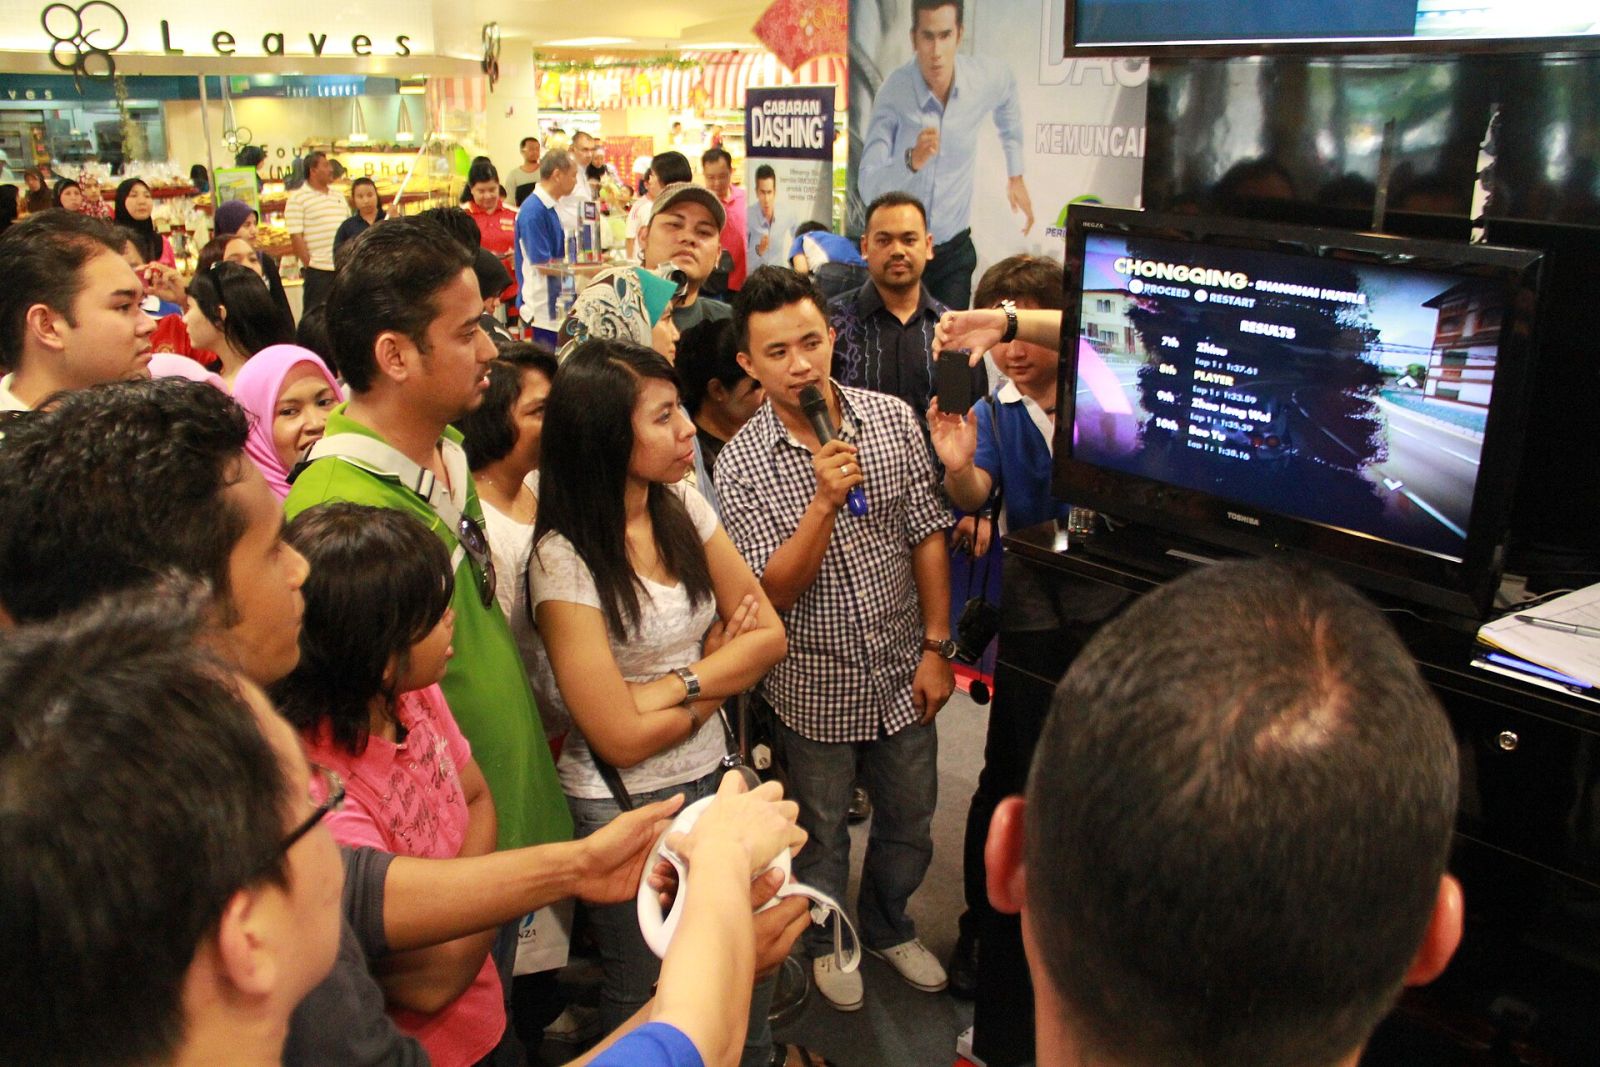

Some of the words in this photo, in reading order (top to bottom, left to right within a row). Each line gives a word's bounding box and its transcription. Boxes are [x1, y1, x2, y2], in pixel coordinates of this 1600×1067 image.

[160, 20, 411, 56] Leaves
[317, 84, 358, 97] Leaves
[763, 100, 821, 116] CABARAN
[751, 106, 825, 150] DASHING
[1113, 257, 1249, 290] CHONGQING
[1254, 280, 1319, 299] SHANGHAI
[1320, 287, 1367, 305] HUSTLE
[1143, 283, 1190, 299] PROCEED
[1209, 293, 1256, 309] RESTART
[1239, 320, 1296, 340] RESULTS
[1161, 335, 1180, 349] 7th
[1195, 357, 1211, 368] Lap
[1193, 369, 1235, 387] PLAYER
[1192, 385, 1208, 396] Lap
[1226, 511, 1261, 527] TOSHIBA
